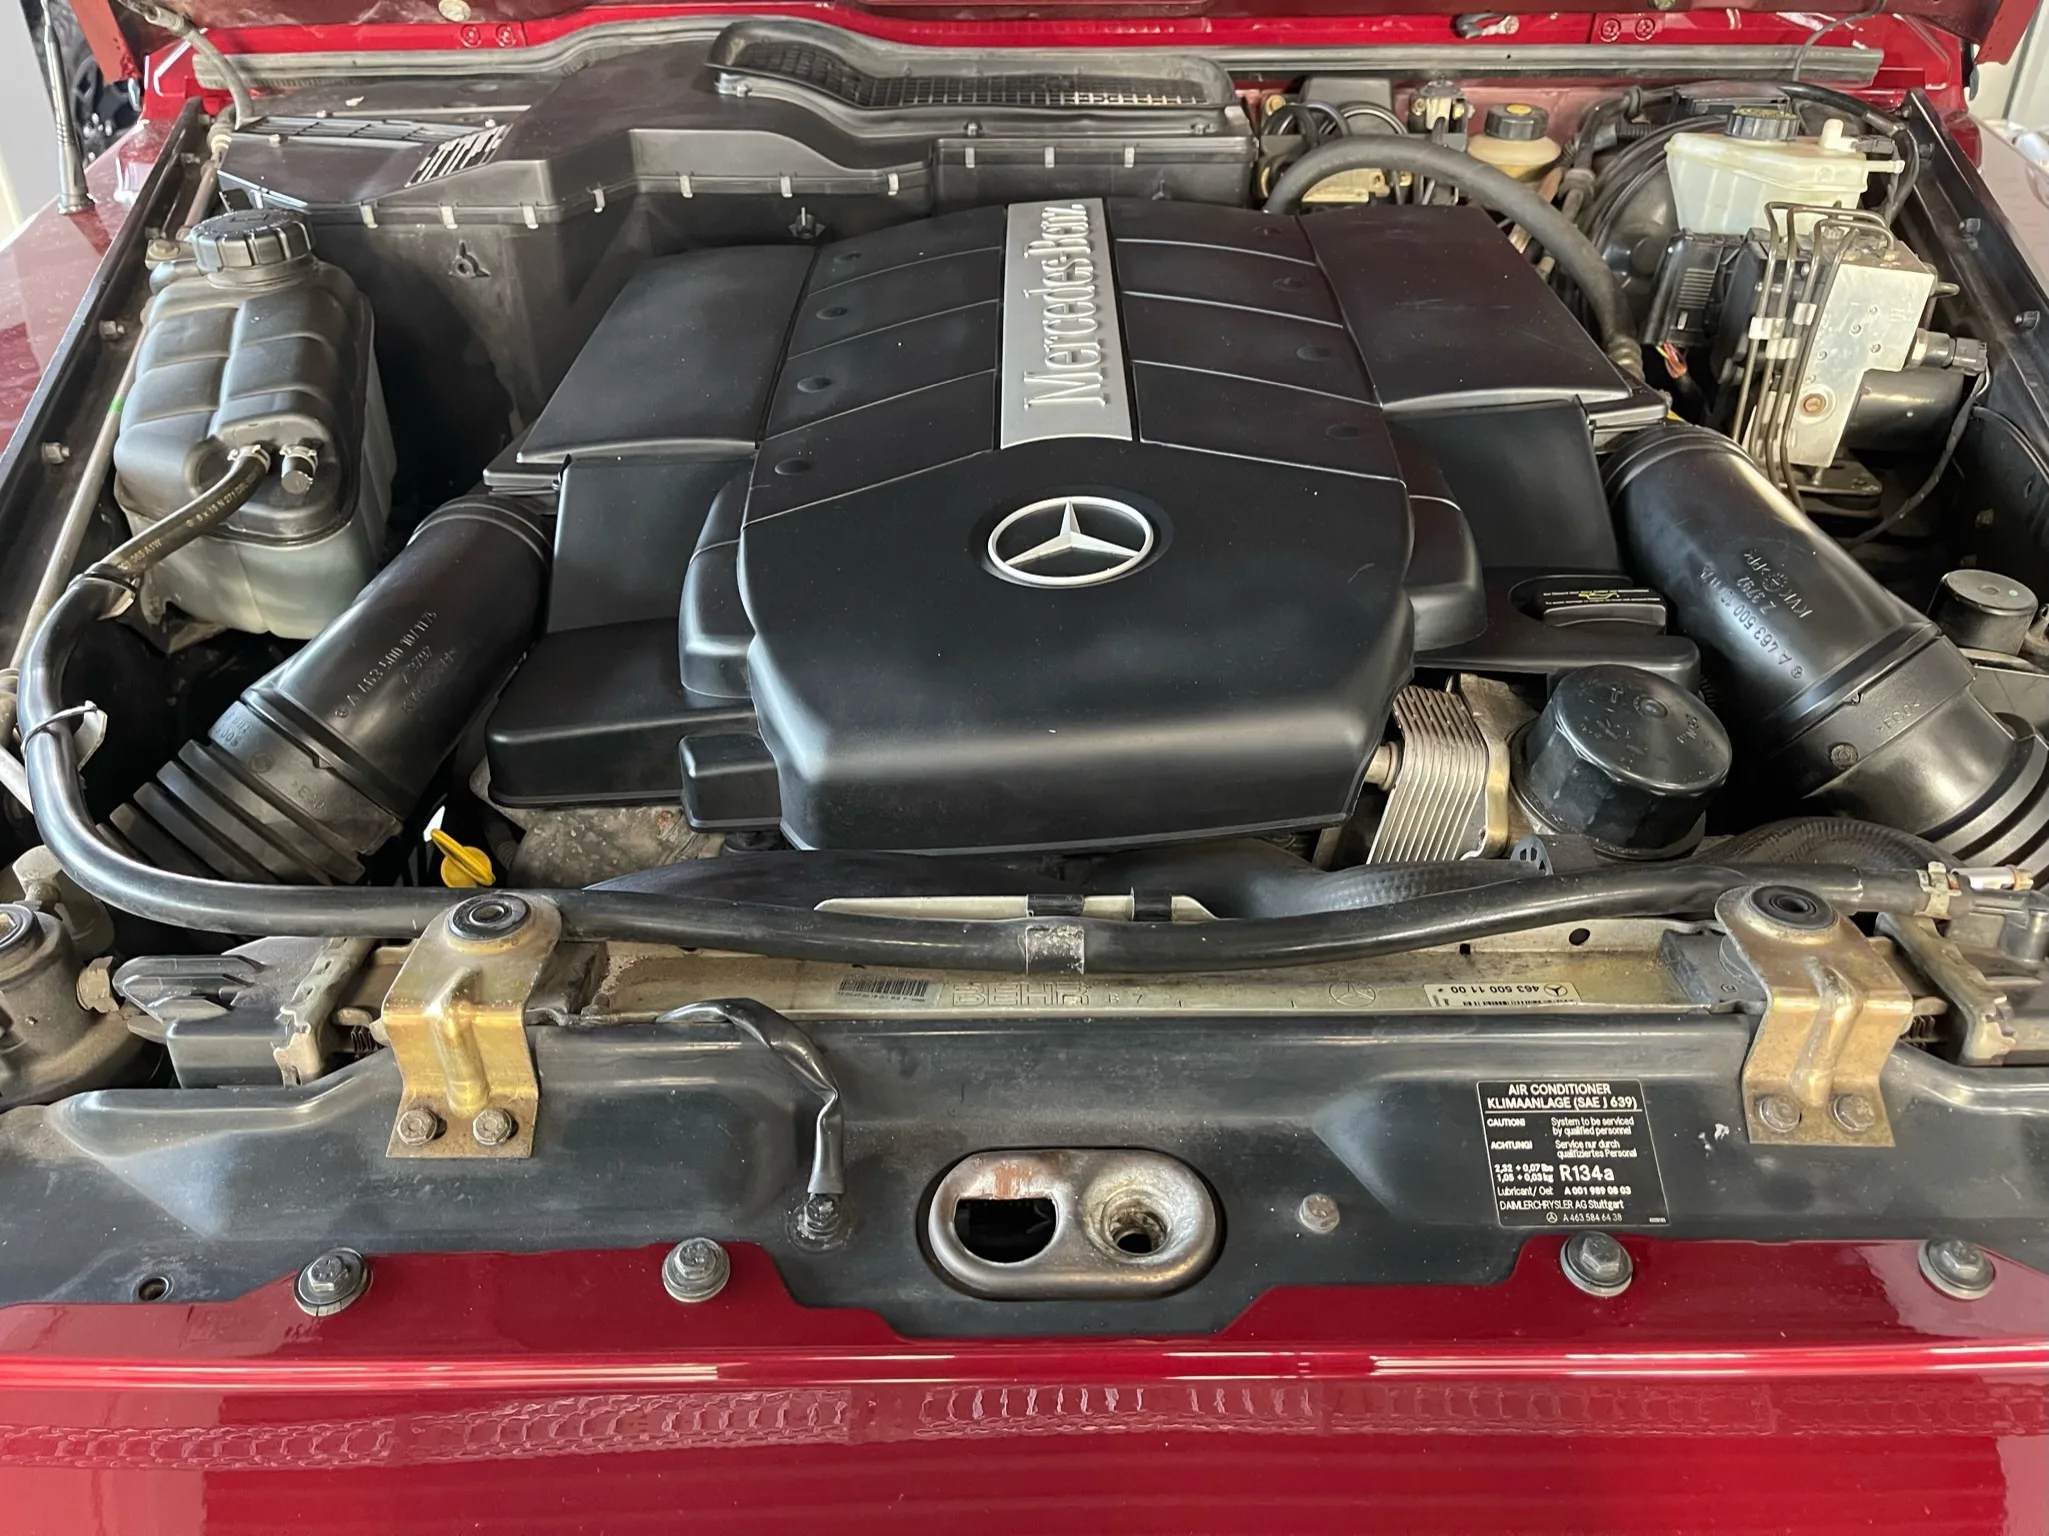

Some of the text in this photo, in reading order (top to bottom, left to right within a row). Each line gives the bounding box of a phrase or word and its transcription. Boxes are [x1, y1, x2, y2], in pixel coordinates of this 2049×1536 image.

[1023, 204, 1106, 411] Mercedes-Benz
[1760, 600, 1776, 615] Z
[1779, 590, 1813, 618] KVK
[1733, 604, 1757, 630] 500
[1754, 627, 1779, 653] 463
[1778, 650, 1792, 665] A
[952, 981, 1091, 1006] BEHR
[1450, 985, 1540, 994] 463 500 11 00
[1508, 1083, 1611, 1096] AIR CONDITIONER
[1487, 1097, 1571, 1109] KLIMAANLAGE
[1573, 1097, 1600, 1110] (SAE
[1610, 1096, 1637, 1110] 639)
[1487, 1118, 1525, 1127] CAUTION!
[1551, 1116, 1634, 1127] System to be serviced
[1552, 1126, 1632, 1136] by qualified personnel
[1490, 1140, 1533, 1150] ACHTUNG!
[1555, 1139, 1620, 1149] Service nur durch
[1556, 1148, 1638, 1159] qualifiziertes Personal
[1522, 1163, 1541, 1173] 0,07
[1559, 1164, 1615, 1182] R134a
[1497, 1186, 1537, 1197] Lubricant/
[1564, 1186, 1571, 1195] A
[1571, 1186, 1588, 1195] 001
[1619, 1186, 1632, 1195] 03
[1499, 1199, 1625, 1211] DAIMLERCHRYSLER AG Stuttgart
[1569, 1213, 1585, 1222] 463
[1585, 1213, 1601, 1222] 584
[1601, 1213, 1612, 1222] 64
[1612, 1213, 1623, 1222] 38
